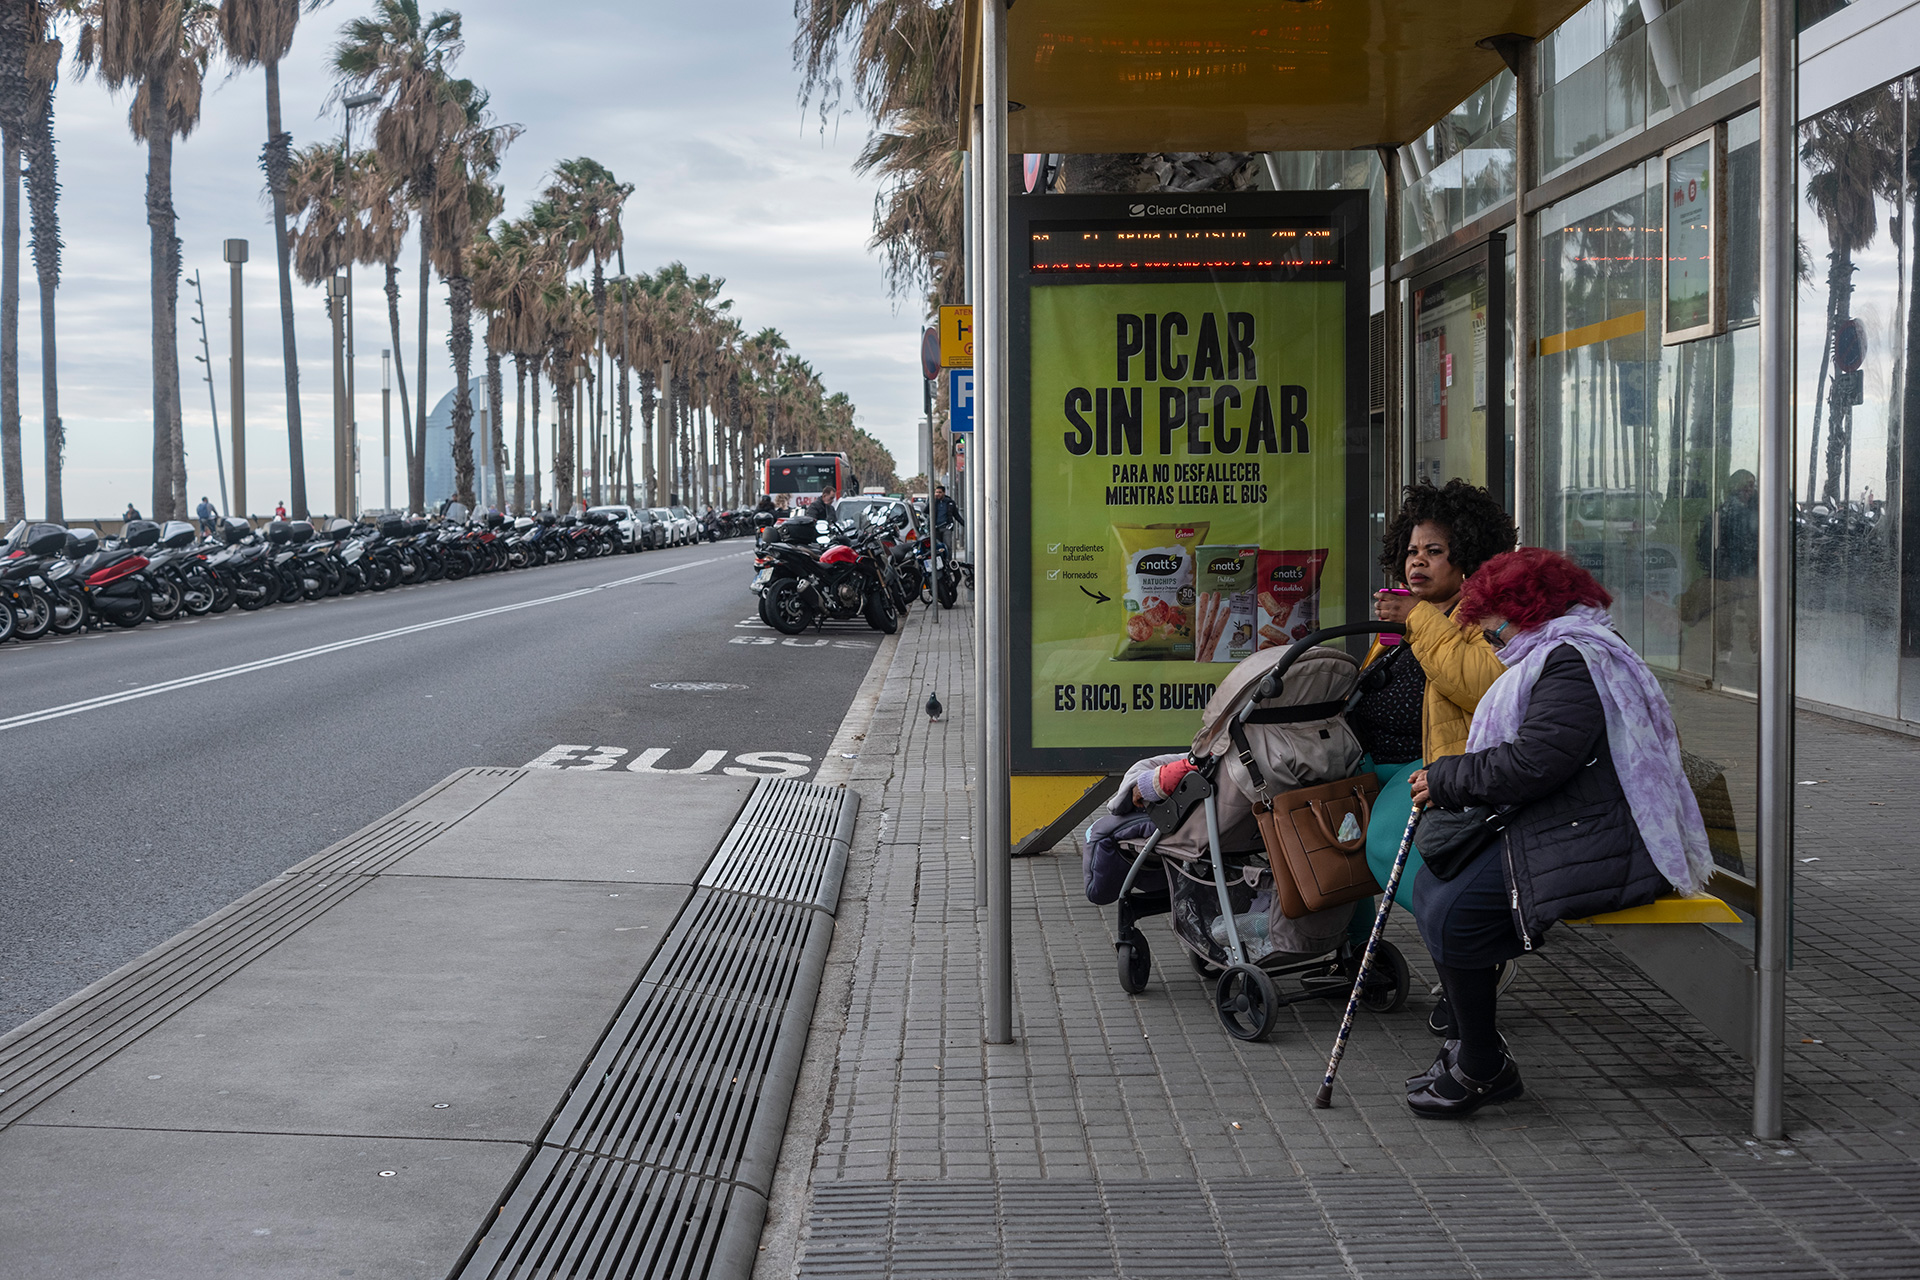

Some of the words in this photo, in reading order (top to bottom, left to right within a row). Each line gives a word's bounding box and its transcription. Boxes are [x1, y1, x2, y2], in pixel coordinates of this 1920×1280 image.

[1147, 204, 1177, 216] Clear
[1180, 203, 1226, 215] Channel
[1116, 312, 1257, 382] PICAR
[1064, 386, 1143, 456] SIN
[1159, 385, 1310, 455] PECAR
[1113, 464, 1148, 483] PARA
[1153, 464, 1169, 483] NO
[1174, 463, 1260, 483] DESFALLECER
[1105, 486, 1174, 505] MIENTRAS
[1178, 485, 1218, 505] LLEGA
[1223, 485, 1238, 504] EL
[1241, 484, 1267, 504] BUS
[1062, 544, 1104, 554] Ingredientes
[1062, 553, 1094, 561] naturales
[1140, 556, 1178, 570] snatt's
[1062, 571, 1098, 579] Horneados
[728, 635, 876, 649] BUS
[1054, 685, 1077, 711] ES
[1081, 684, 1127, 714] RICO,
[1133, 684, 1154, 711] ES
[521, 744, 813, 778] BUS
